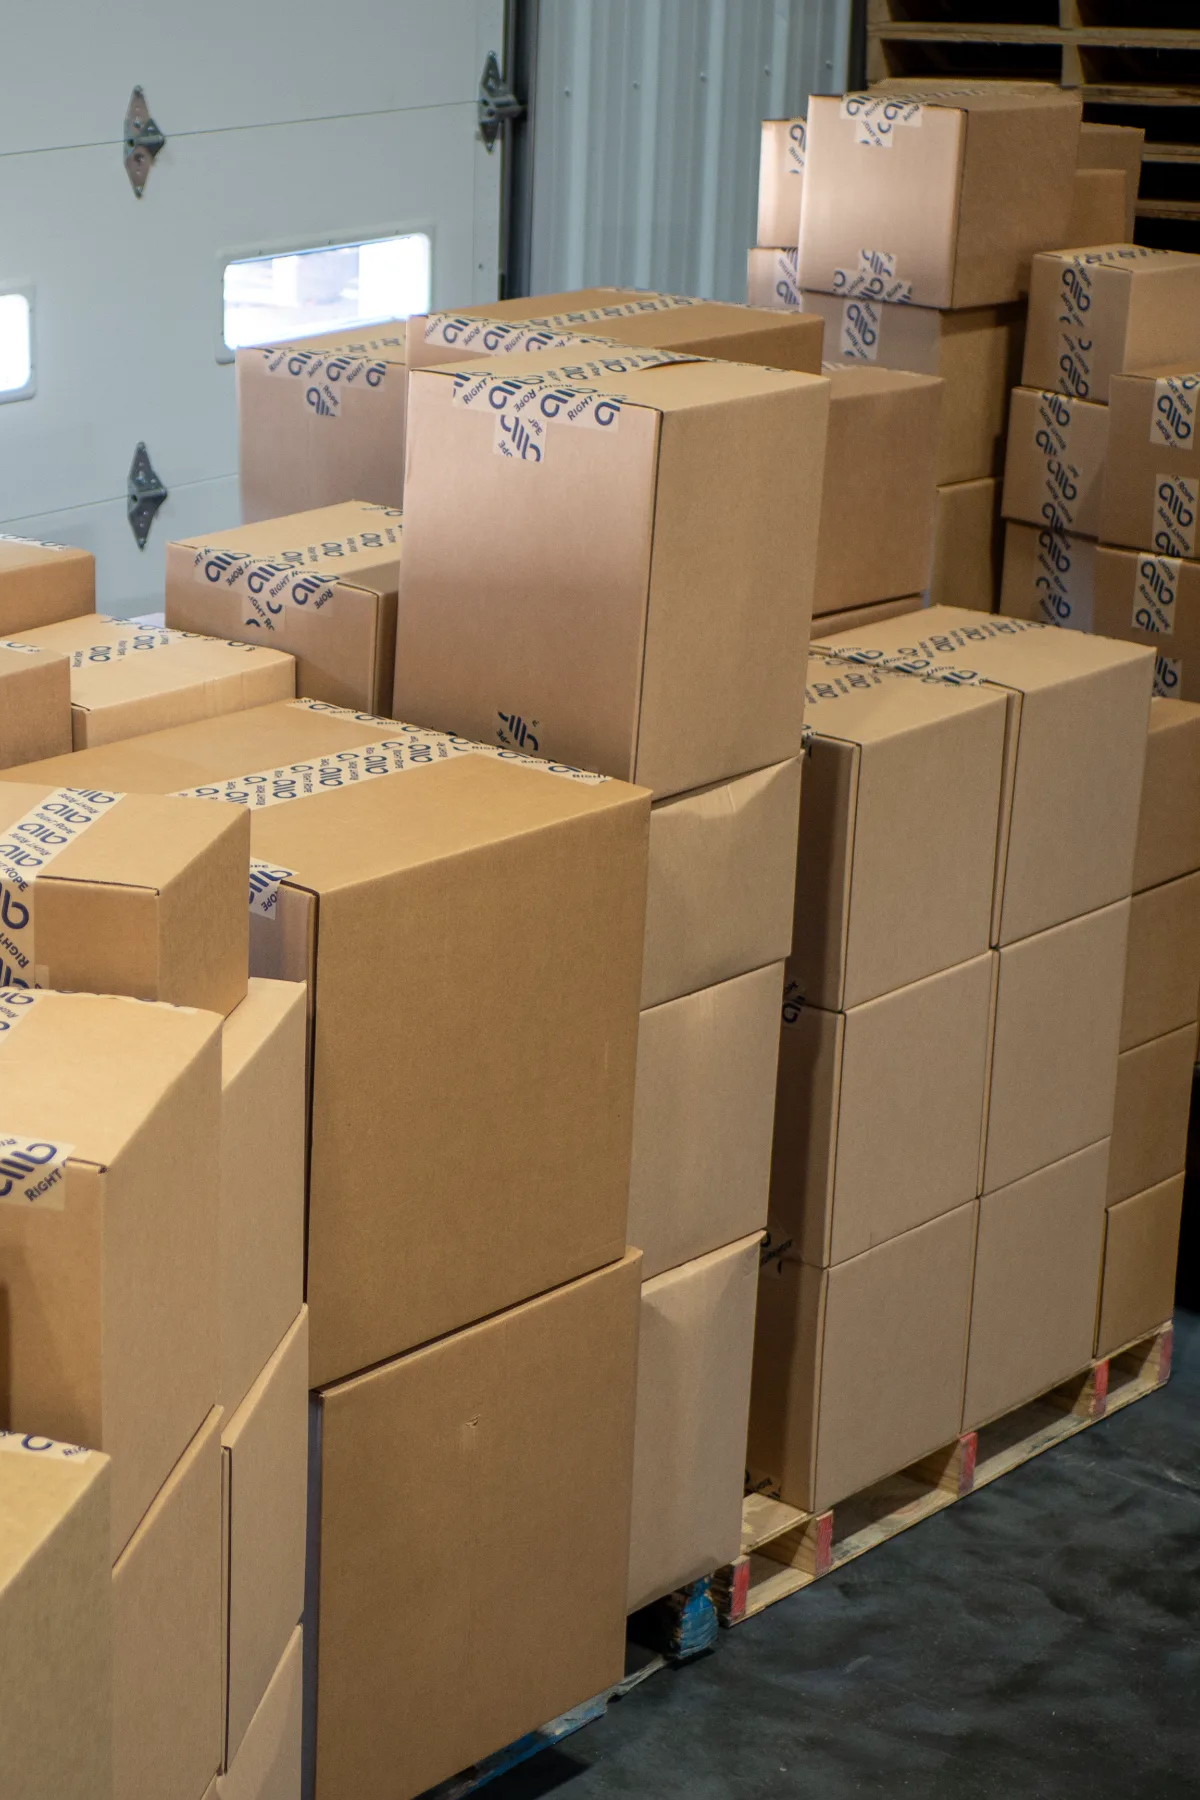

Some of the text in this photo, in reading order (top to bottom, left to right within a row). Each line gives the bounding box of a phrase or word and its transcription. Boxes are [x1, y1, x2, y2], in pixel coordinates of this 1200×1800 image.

[504, 329, 525, 353] RIGHT
[462, 378, 487, 405] RIGHT
[514, 389, 537, 412] ROPE
[567, 395, 593, 421] RIGHT
[226, 566, 245, 587] ROPE
[269, 574, 291, 598] RIGHT
[314, 589, 334, 609] ROPE
[5, 867, 30, 892] ROPE
[261, 891, 277, 911] OPE
[24, 1168, 64, 1202] RIGHT
